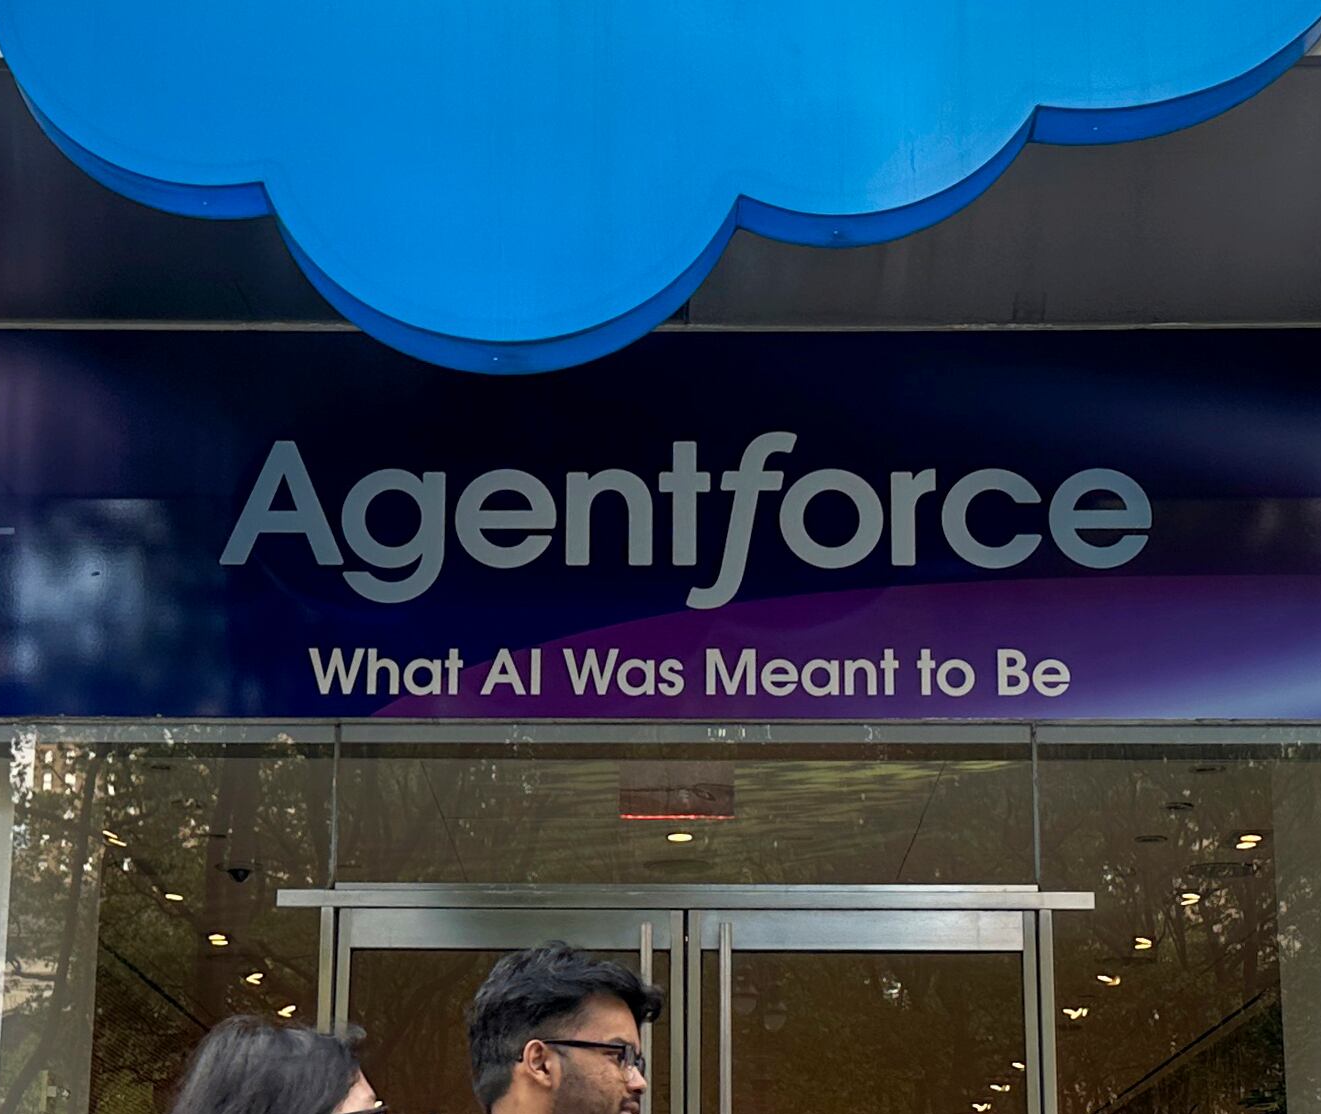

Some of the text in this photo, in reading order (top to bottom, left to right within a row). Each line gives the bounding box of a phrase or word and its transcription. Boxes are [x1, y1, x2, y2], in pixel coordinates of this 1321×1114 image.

[218, 430, 1154, 610] Agentforce
[308, 648, 1072, 697] What AI Was Meant to Be
